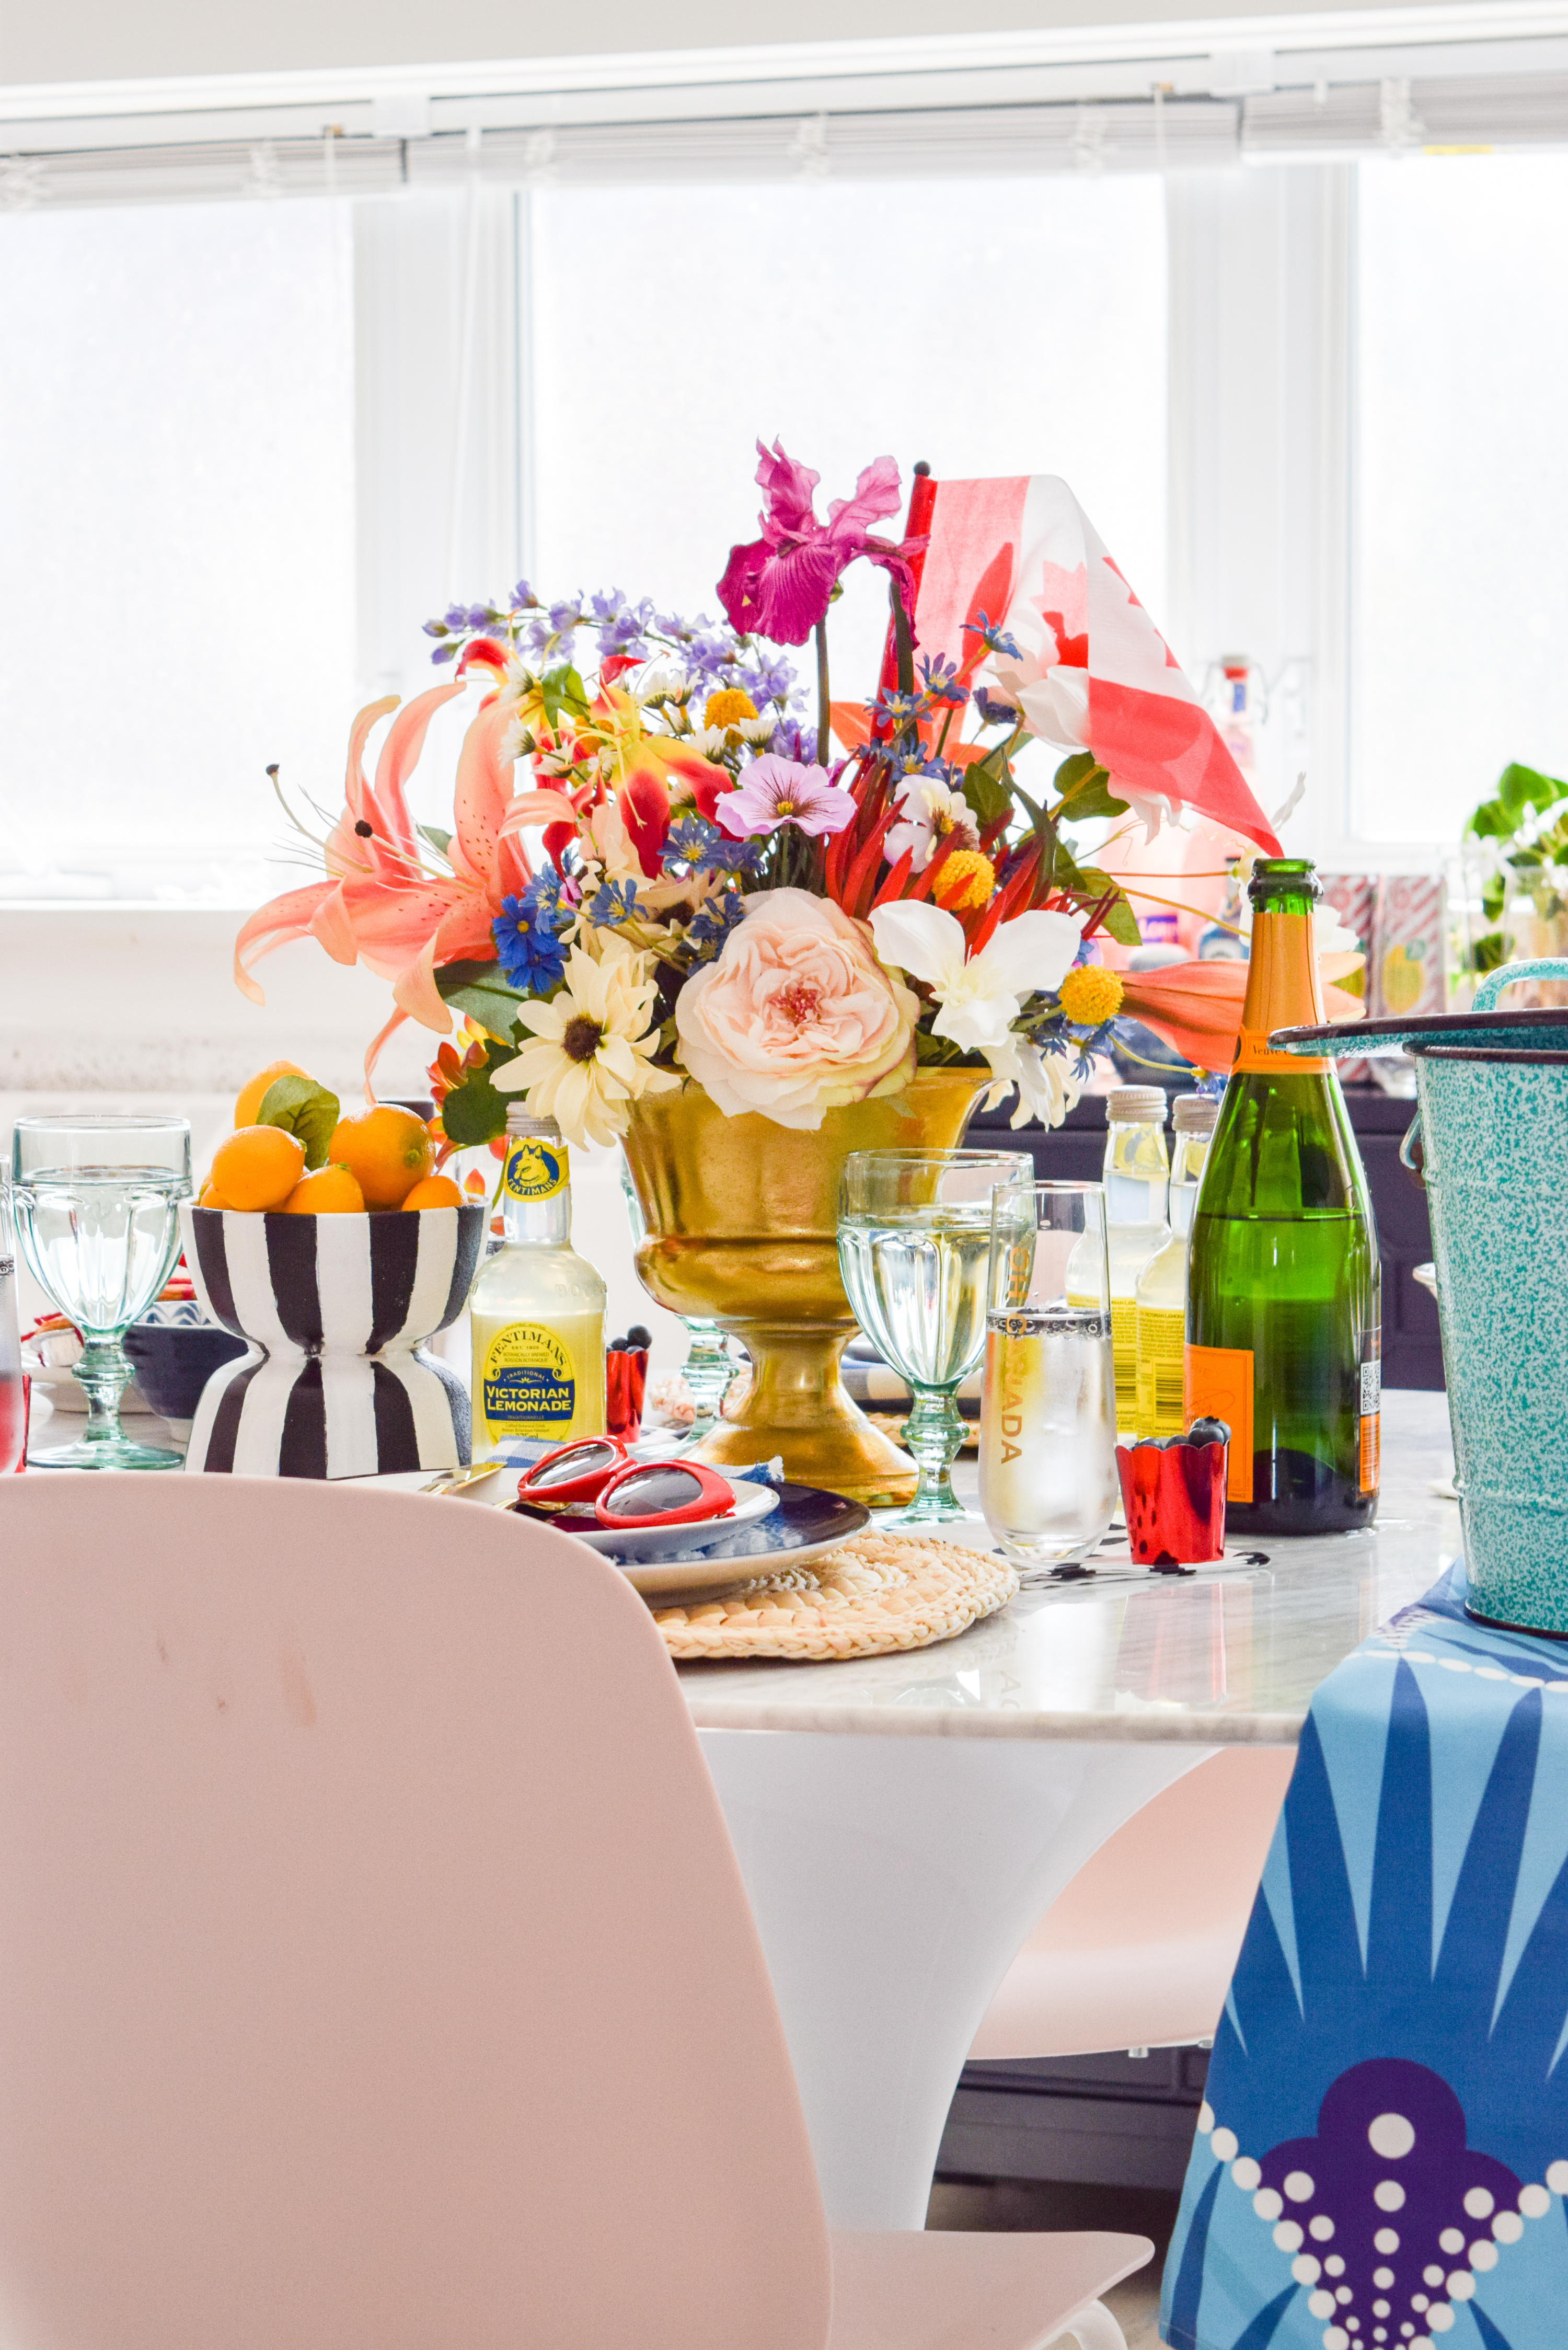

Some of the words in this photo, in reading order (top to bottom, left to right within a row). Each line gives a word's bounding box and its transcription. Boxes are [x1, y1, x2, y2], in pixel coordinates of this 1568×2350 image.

[508, 1178, 557, 1195] FENTIMANS
[1008, 1246, 1030, 1298] OH
[490, 1330, 567, 1366] FENTIMANS
[506, 1370, 545, 1380] TRADITIONAL
[486, 1385, 569, 1399] VICTORIAN
[487, 1398, 572, 1411] LEMONADE
